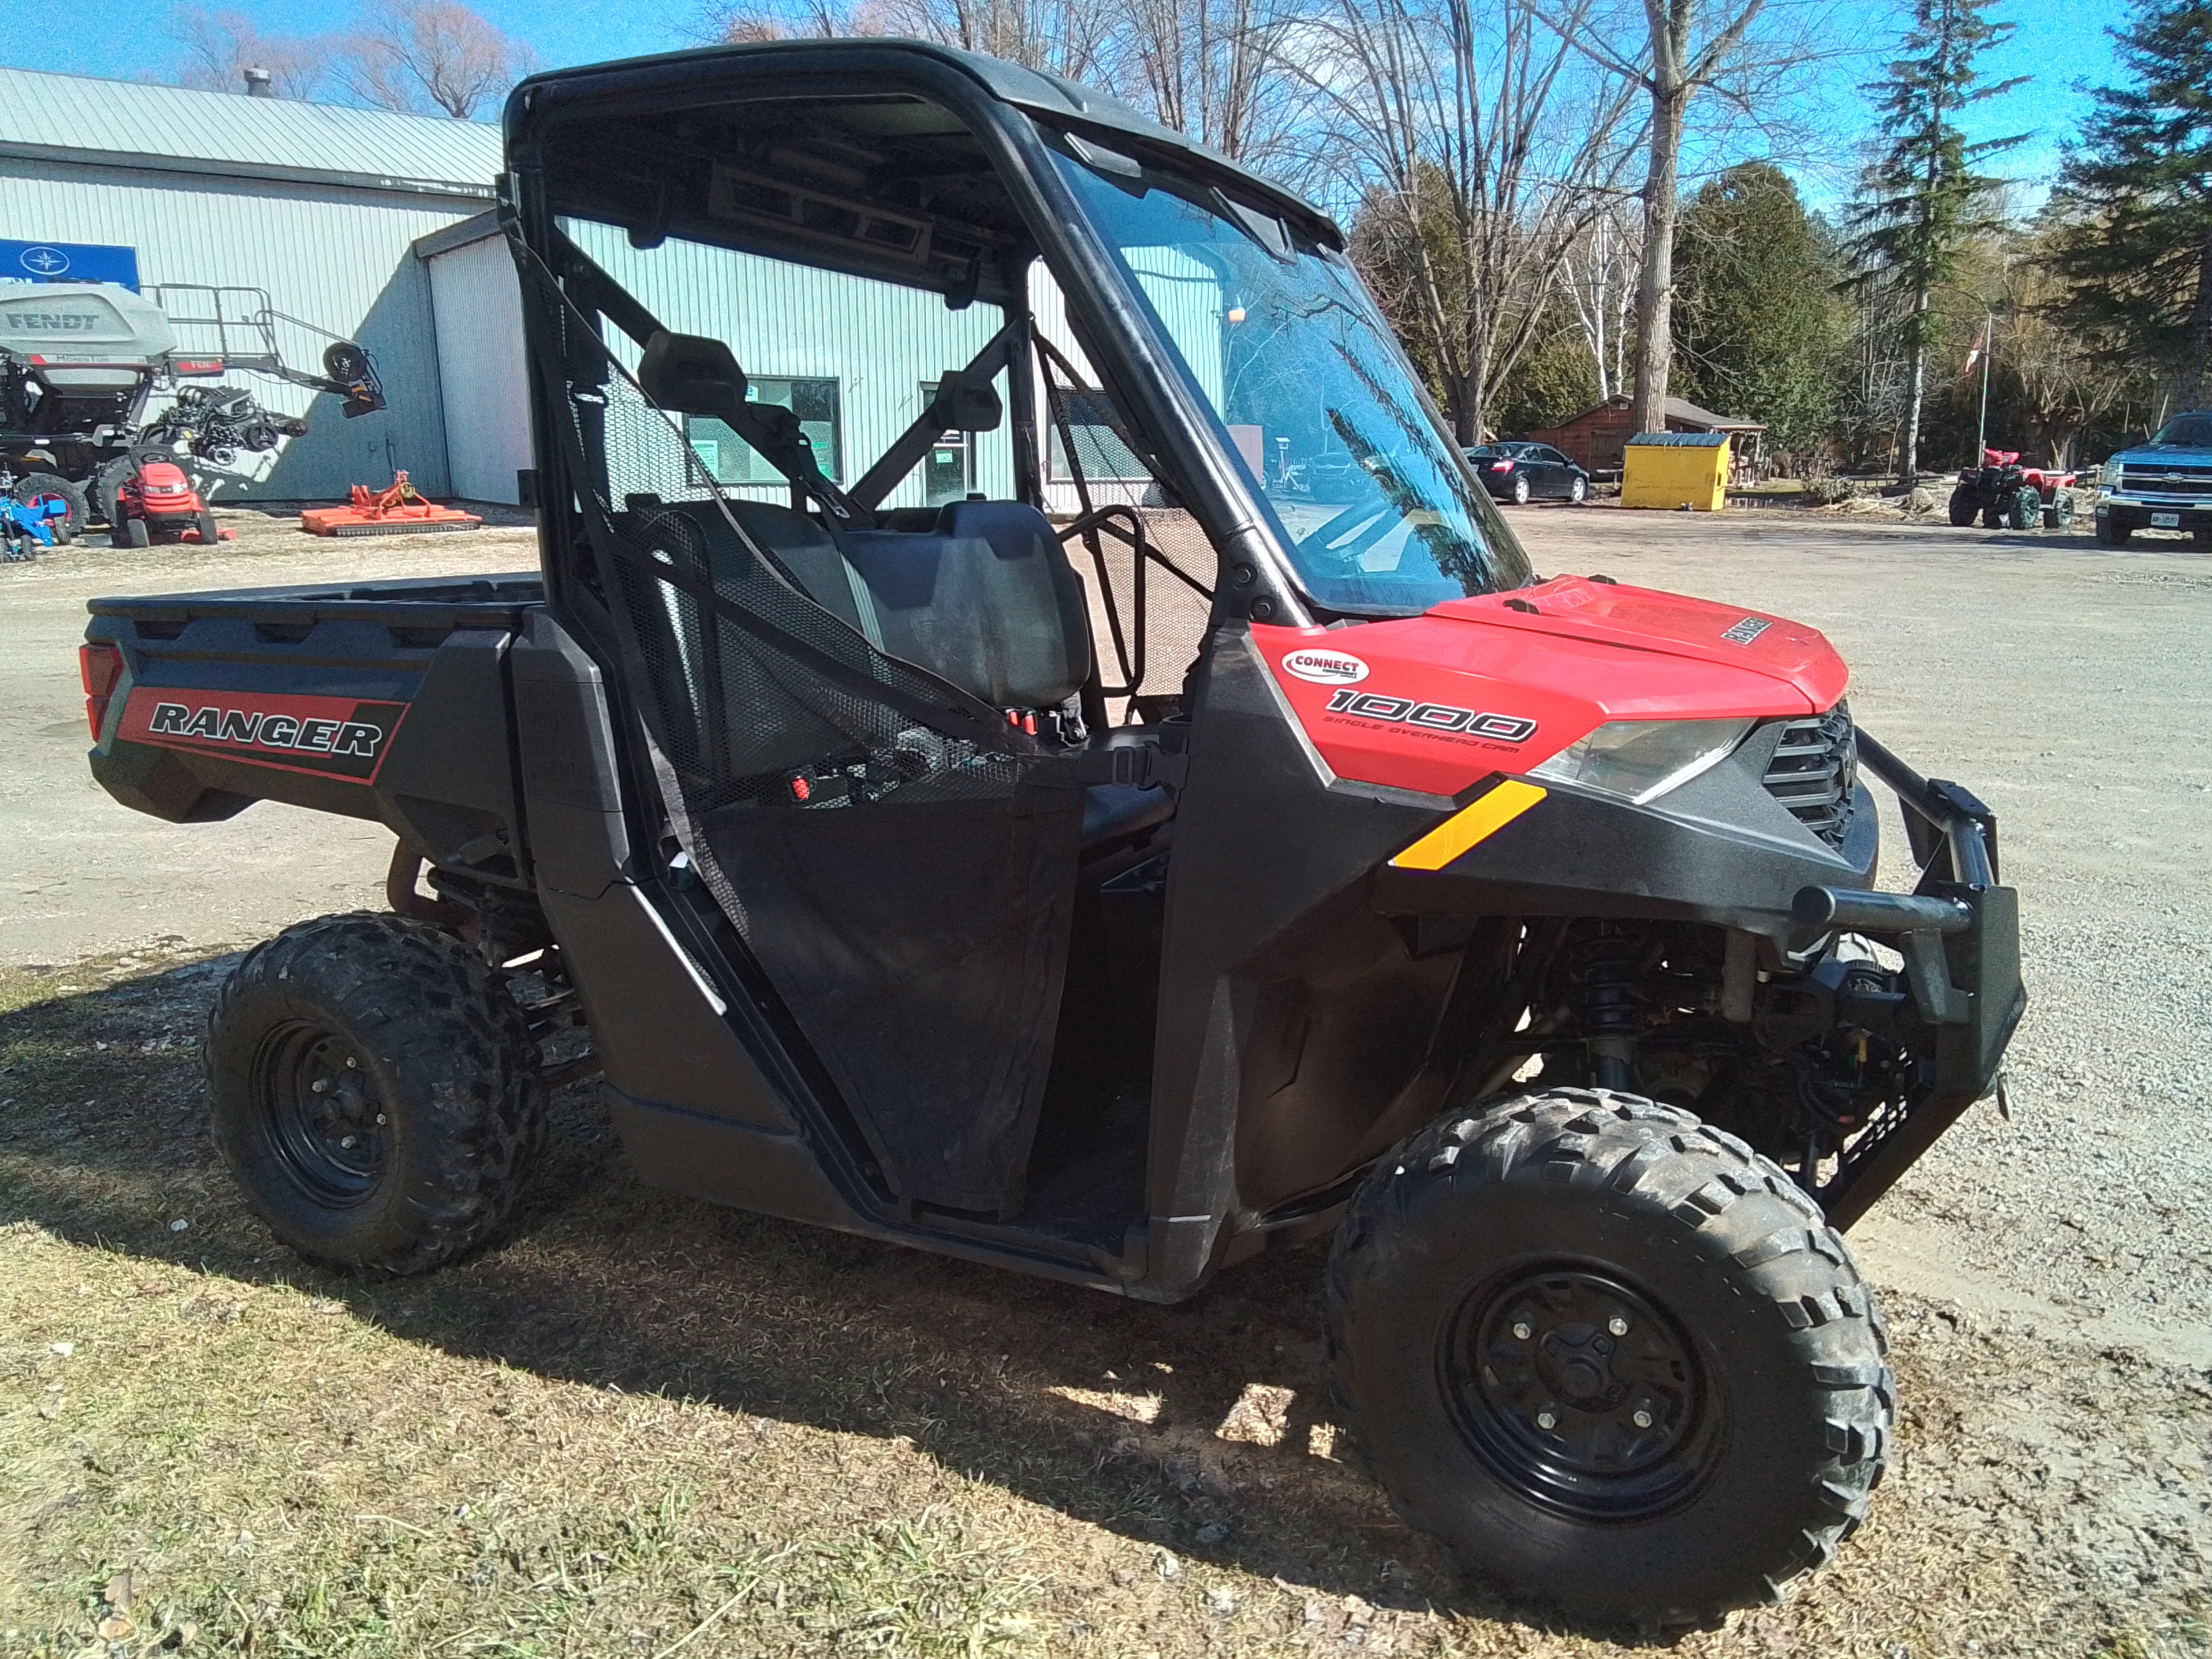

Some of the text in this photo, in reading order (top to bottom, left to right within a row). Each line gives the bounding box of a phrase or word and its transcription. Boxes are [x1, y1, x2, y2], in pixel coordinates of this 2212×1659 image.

[5, 312, 100, 330] FENDT
[1295, 655, 1359, 672] CONNECT
[148, 702, 382, 757] RANGER
[1324, 688, 1538, 743] 1000
[1323, 716, 1521, 754] SINGLE OVERHEAD CAM
